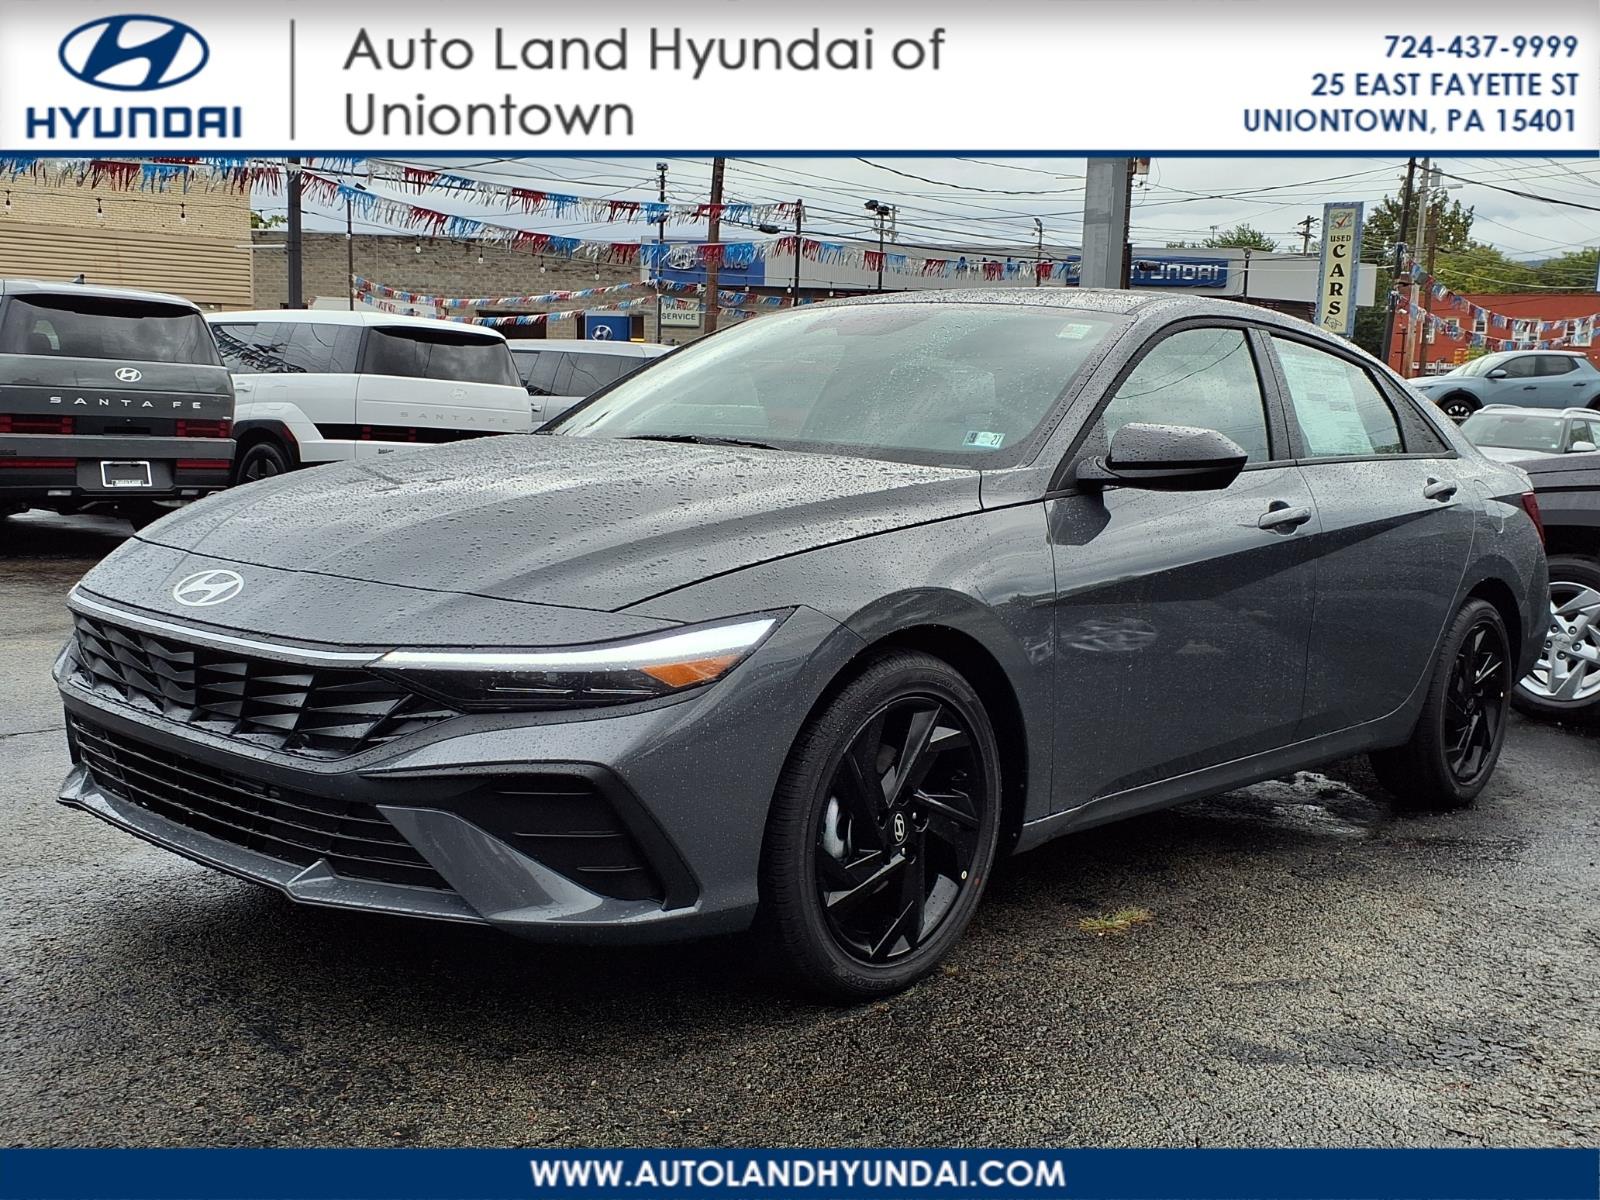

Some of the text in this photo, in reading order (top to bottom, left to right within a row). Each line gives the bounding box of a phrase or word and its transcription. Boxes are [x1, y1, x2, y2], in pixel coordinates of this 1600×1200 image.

[1327, 244, 1346, 315] CARS
[661, 313, 696, 321] SERVICE
[50, 396, 201, 409] SANTA FE
[400, 411, 478, 423] SANTA
